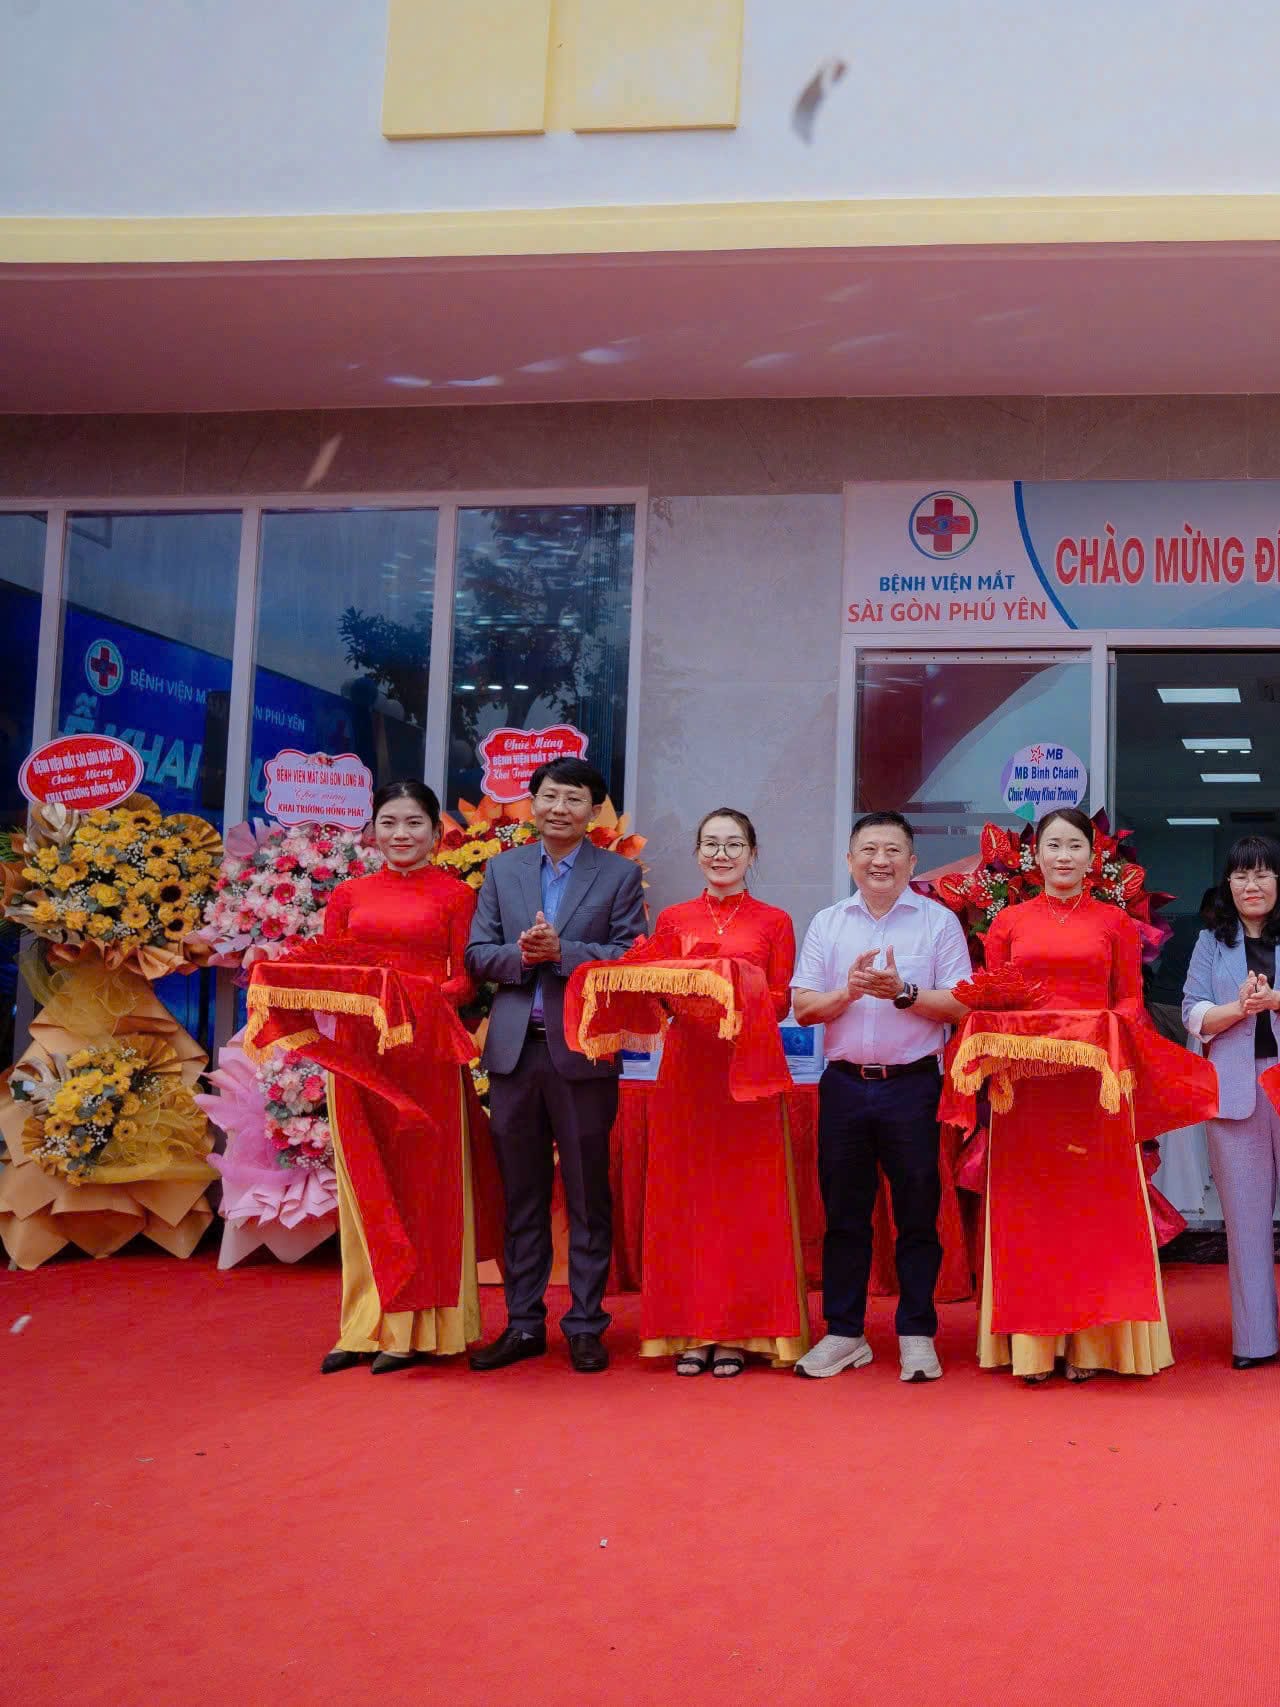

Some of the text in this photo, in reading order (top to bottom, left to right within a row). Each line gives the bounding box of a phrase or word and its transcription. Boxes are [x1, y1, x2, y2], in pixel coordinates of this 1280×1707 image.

[1057, 523, 1145, 584] CHÀO
[1155, 523, 1245, 584] MỪNG
[879, 570, 1015, 594] BỆNH VIỆN MẮT
[848, 596, 1046, 622] SÀI GÒN PHÚ YÊN
[130, 669, 164, 693] BỆNH
[167, 680, 193, 703] VIỆN
[287, 714, 305, 732] YÊN
[504, 737, 563, 752] Chúc Mừng
[493, 754, 512, 766] BỆNH
[513, 753, 529, 766] VIỆN
[531, 751, 546, 763] MẮT
[1046, 749, 1063, 760] MB
[51, 774, 75, 785] Chúc
[343, 773, 356, 787] LONG
[358, 774, 364, 787] AN
[1015, 767, 1029, 779] MB
[45, 792, 63, 803] KHAI
[109, 778, 127, 793] PHÁT
[1008, 787, 1078, 805] Chúc Mừng Khai Trương
[278, 803, 294, 812] KHAI
[296, 803, 324, 815] TRƯƠNG
[348, 806, 364, 817] PHÁT
